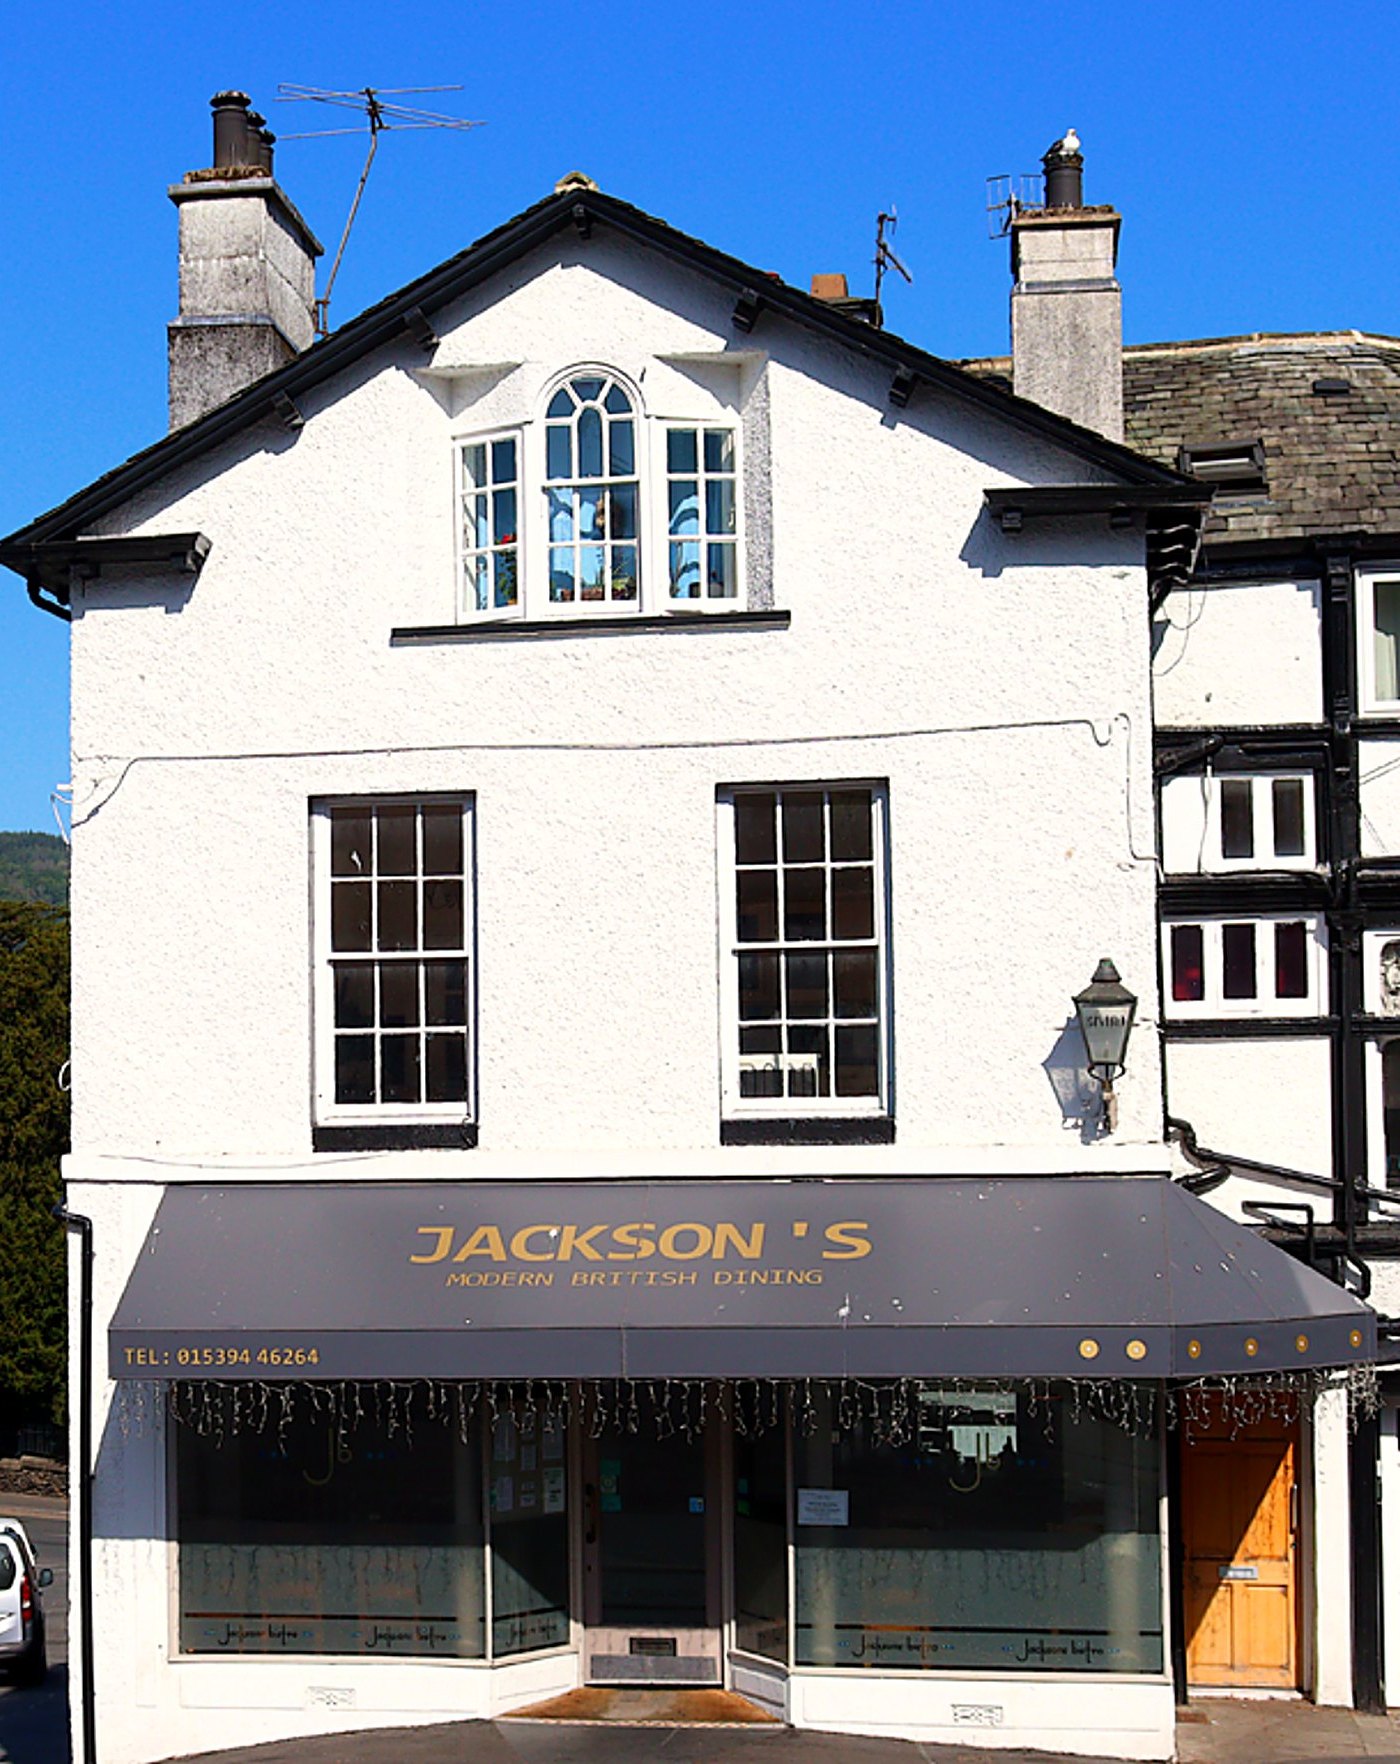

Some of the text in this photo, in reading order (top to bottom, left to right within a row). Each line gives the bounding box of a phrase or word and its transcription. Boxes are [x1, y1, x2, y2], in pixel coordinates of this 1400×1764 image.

[409, 1222, 765, 1264] JACKSON
[445, 1268, 823, 1287] MODERN BRITISH DINING
[124, 1348, 320, 1365] TEL: 015394 46264
